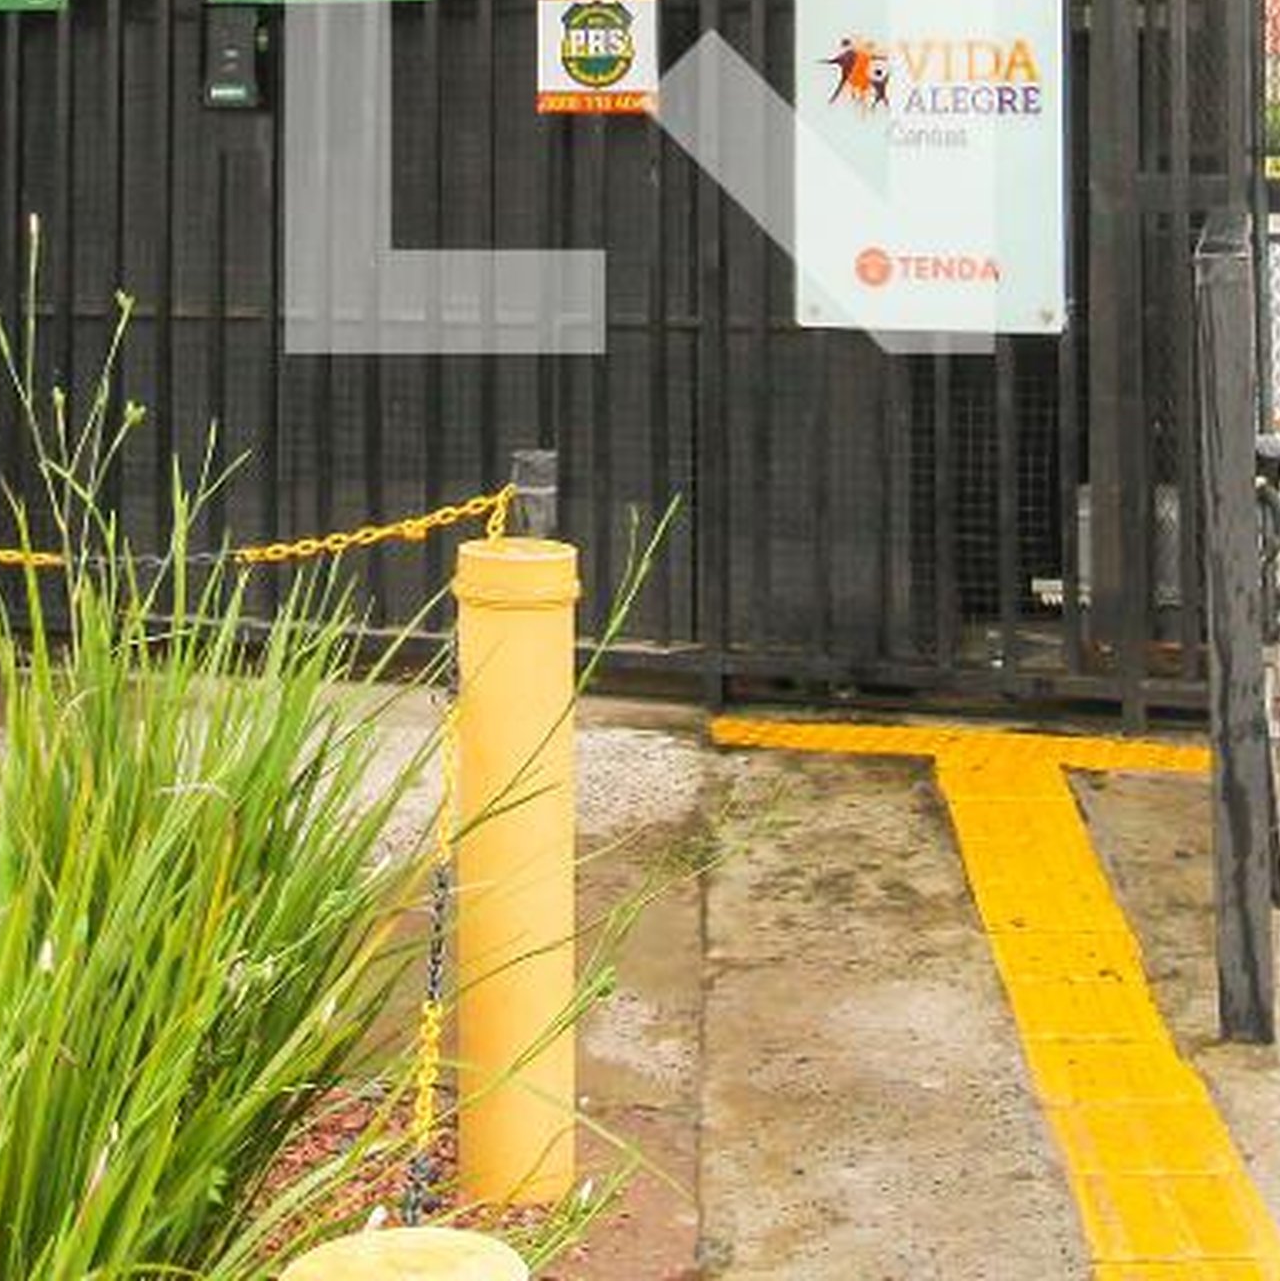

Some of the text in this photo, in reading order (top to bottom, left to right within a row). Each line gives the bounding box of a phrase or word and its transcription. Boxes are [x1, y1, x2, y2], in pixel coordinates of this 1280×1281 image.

[898, 39, 1041, 82] VIDA
[904, 85, 1042, 115] ALEGRE
[897, 255, 1000, 282] TENDA
